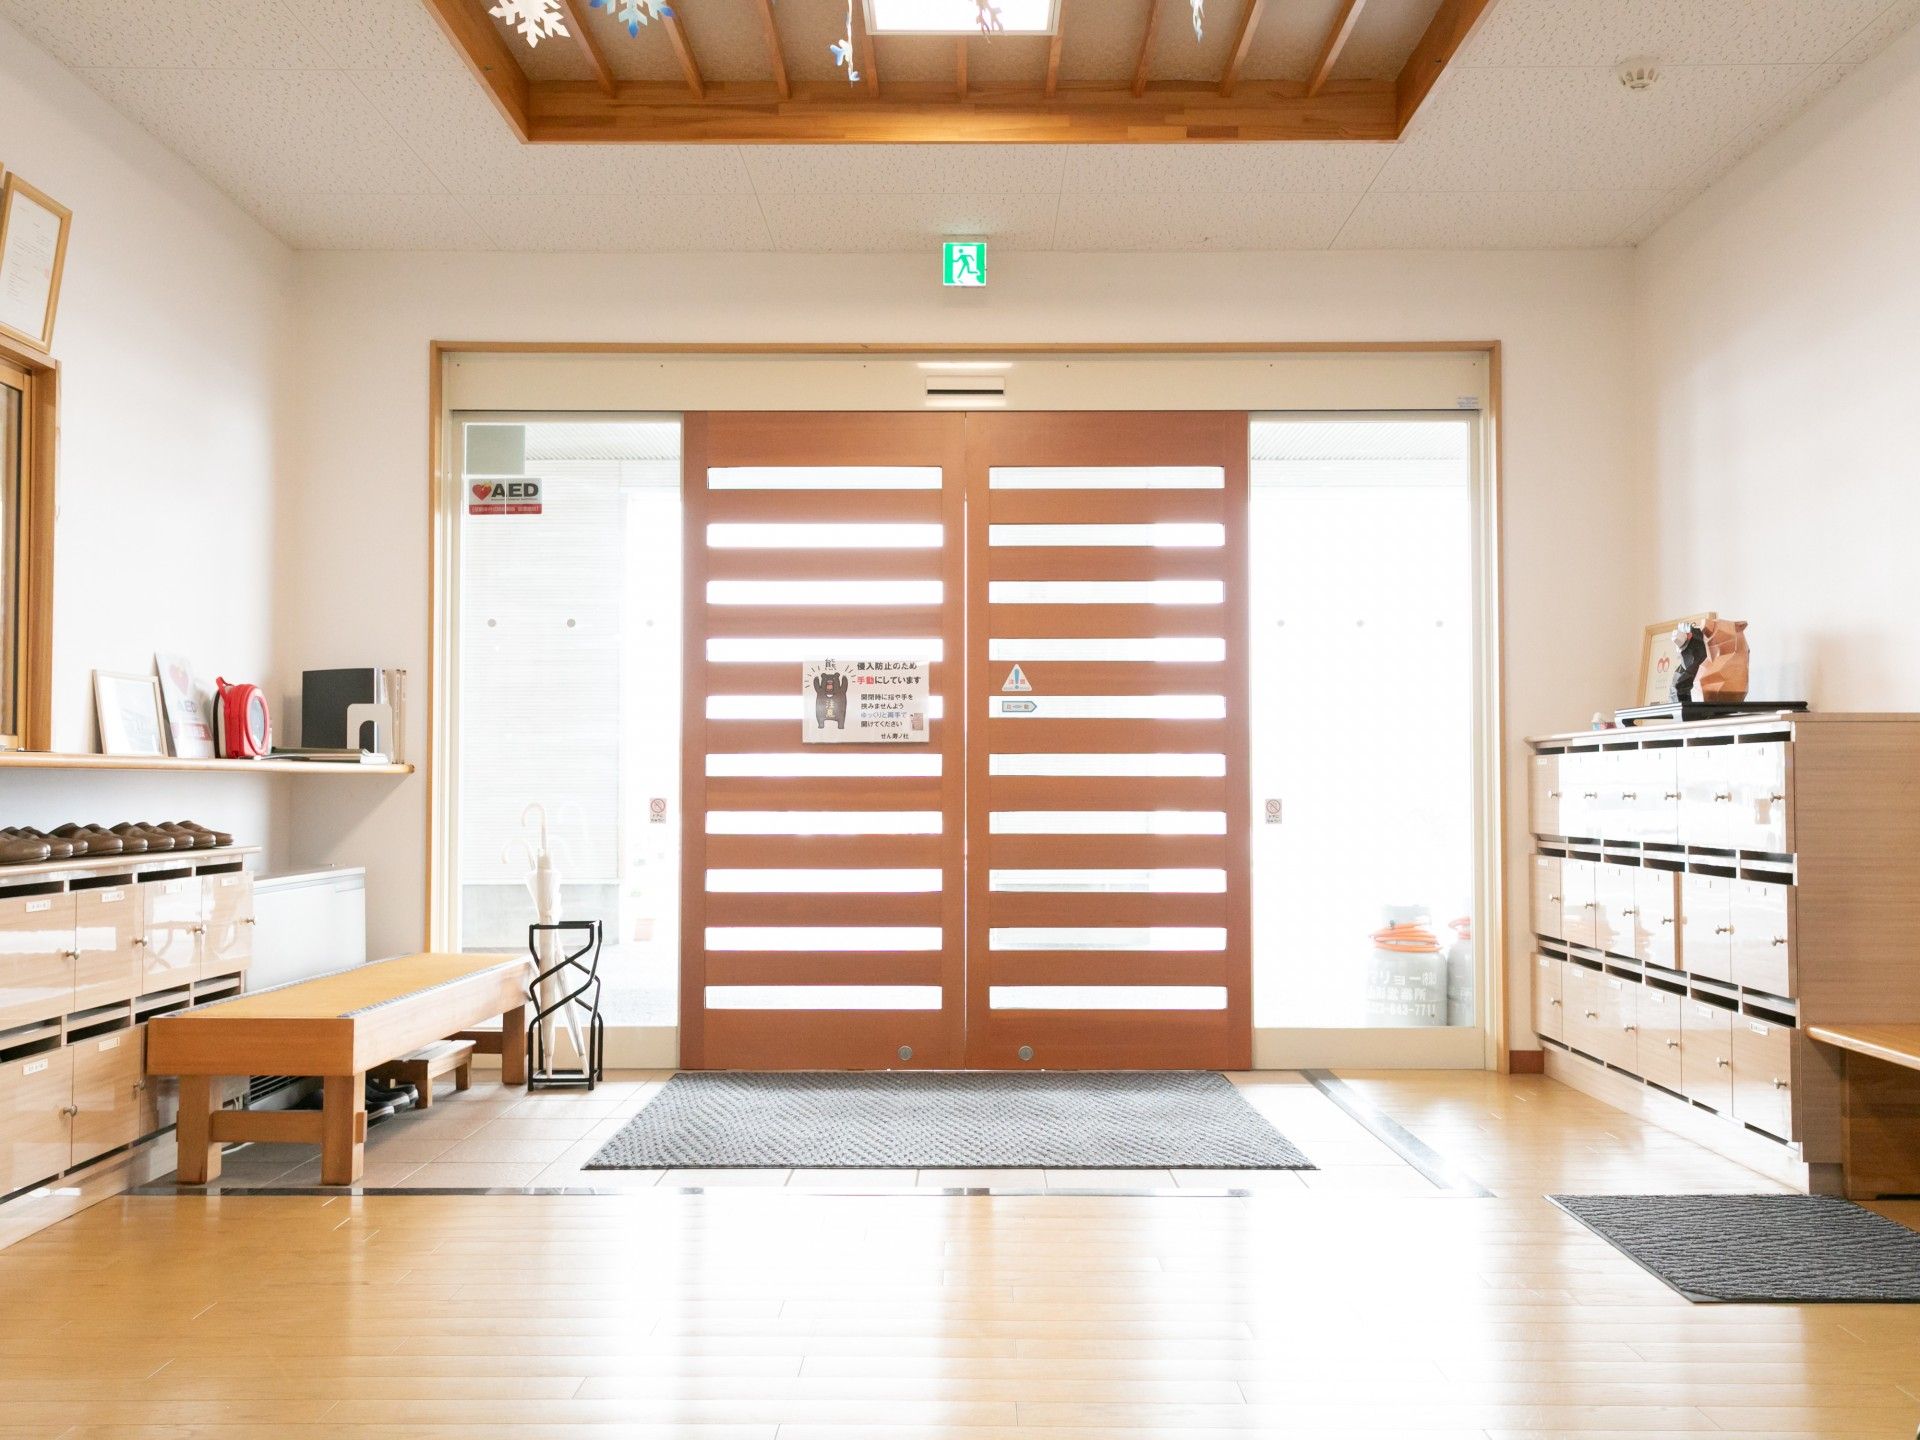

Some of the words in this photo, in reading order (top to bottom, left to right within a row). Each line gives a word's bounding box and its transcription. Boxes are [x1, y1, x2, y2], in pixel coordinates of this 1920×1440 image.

[491, 483, 538, 497] AED
[857, 662, 917, 670] 侵入防止のため
[857, 676, 921, 685] 手動にしています
